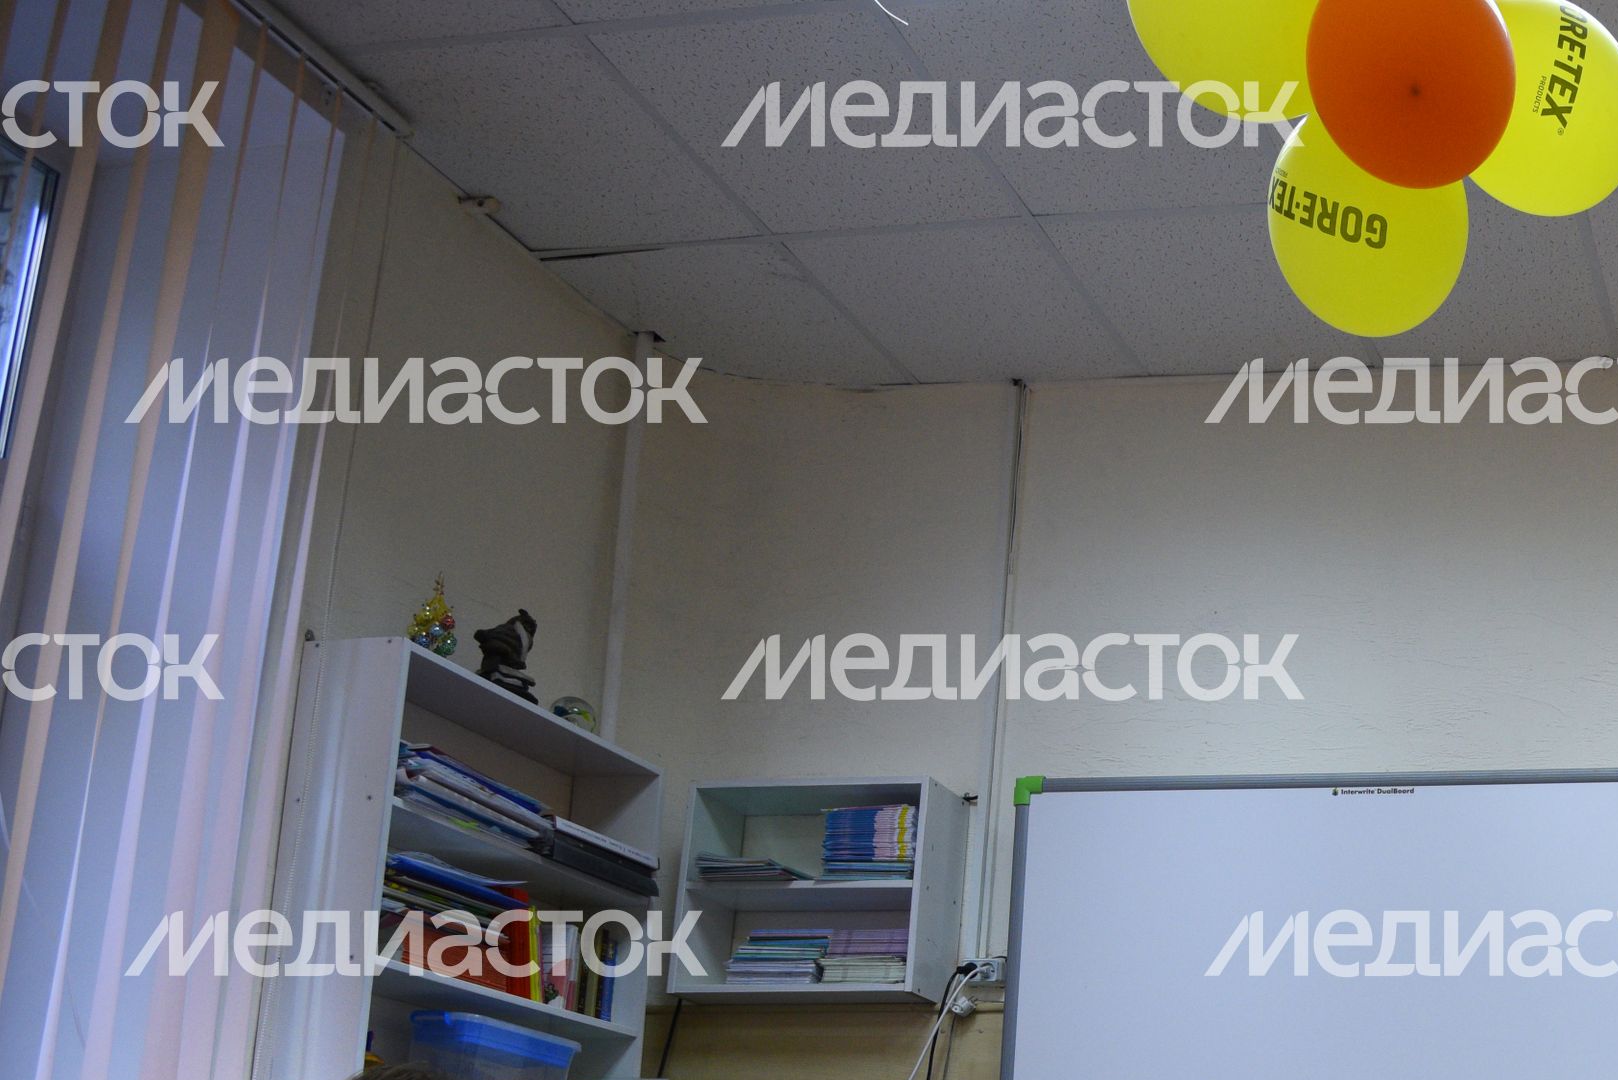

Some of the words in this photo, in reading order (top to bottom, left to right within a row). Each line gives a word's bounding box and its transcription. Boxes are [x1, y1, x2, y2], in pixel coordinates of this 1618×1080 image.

[1533, 75, 1547, 113] PRODUCTS
[1541, 5, 1588, 128] ORE-TEX
[1269, 176, 1388, 249] GORE-TEX
